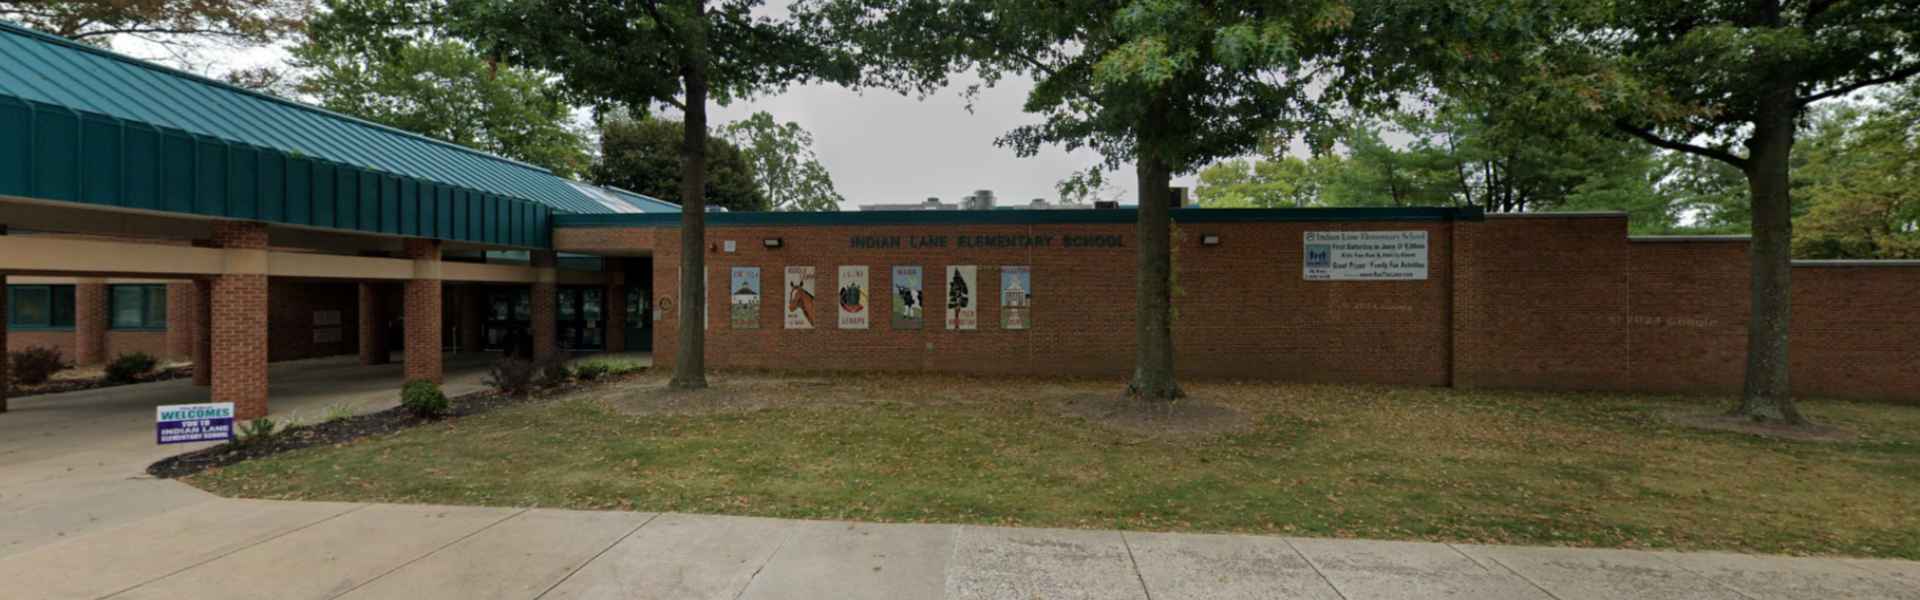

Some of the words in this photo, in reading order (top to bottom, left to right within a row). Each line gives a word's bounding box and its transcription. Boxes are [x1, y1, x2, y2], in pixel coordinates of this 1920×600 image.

[1317, 232, 1340, 240] Indian
[1341, 232, 1359, 240] Lane
[1360, 231, 1400, 241] Elementary
[1401, 231, 1425, 240] School
[850, 235, 901, 249] INDIAN
[910, 235, 947, 249] LANE
[957, 234, 1054, 248] ELEMENTARY
[1063, 234, 1125, 248] SCHOOL
[161, 407, 230, 420] WELCOMES
[182, 420, 198, 428] YOU
[161, 427, 199, 435] INDIAN
